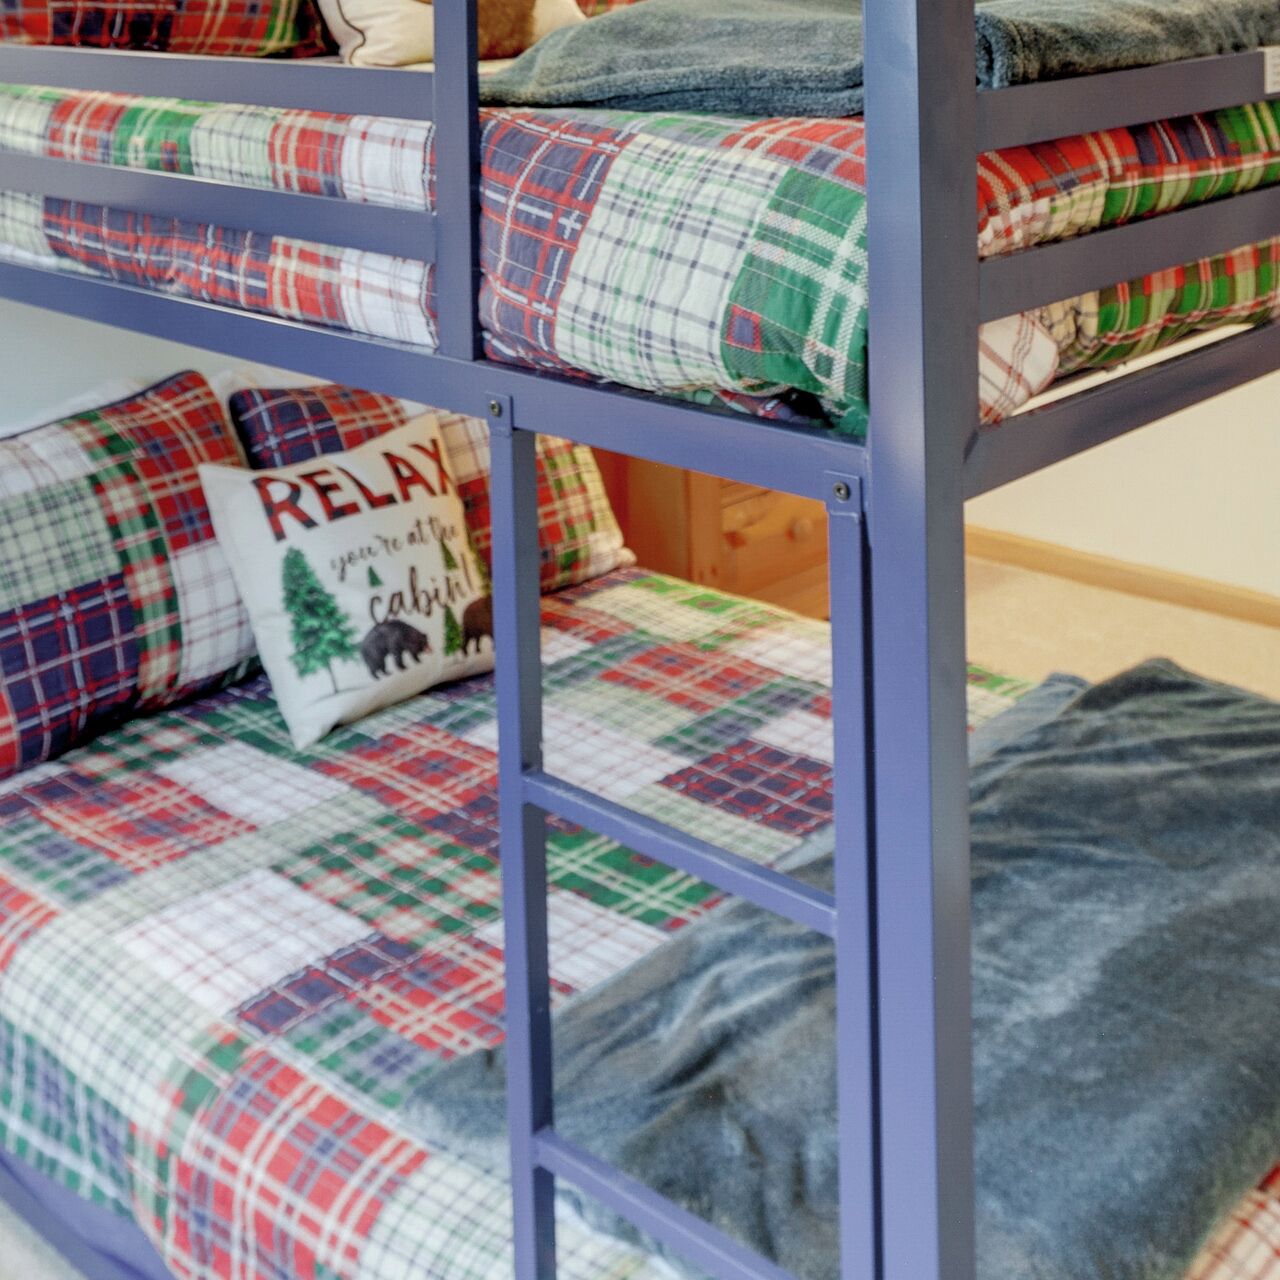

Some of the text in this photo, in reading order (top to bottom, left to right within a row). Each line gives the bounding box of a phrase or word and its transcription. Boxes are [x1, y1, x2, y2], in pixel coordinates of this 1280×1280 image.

[251, 438, 456, 542] RELAX
[330, 516, 457, 582] you're at the
